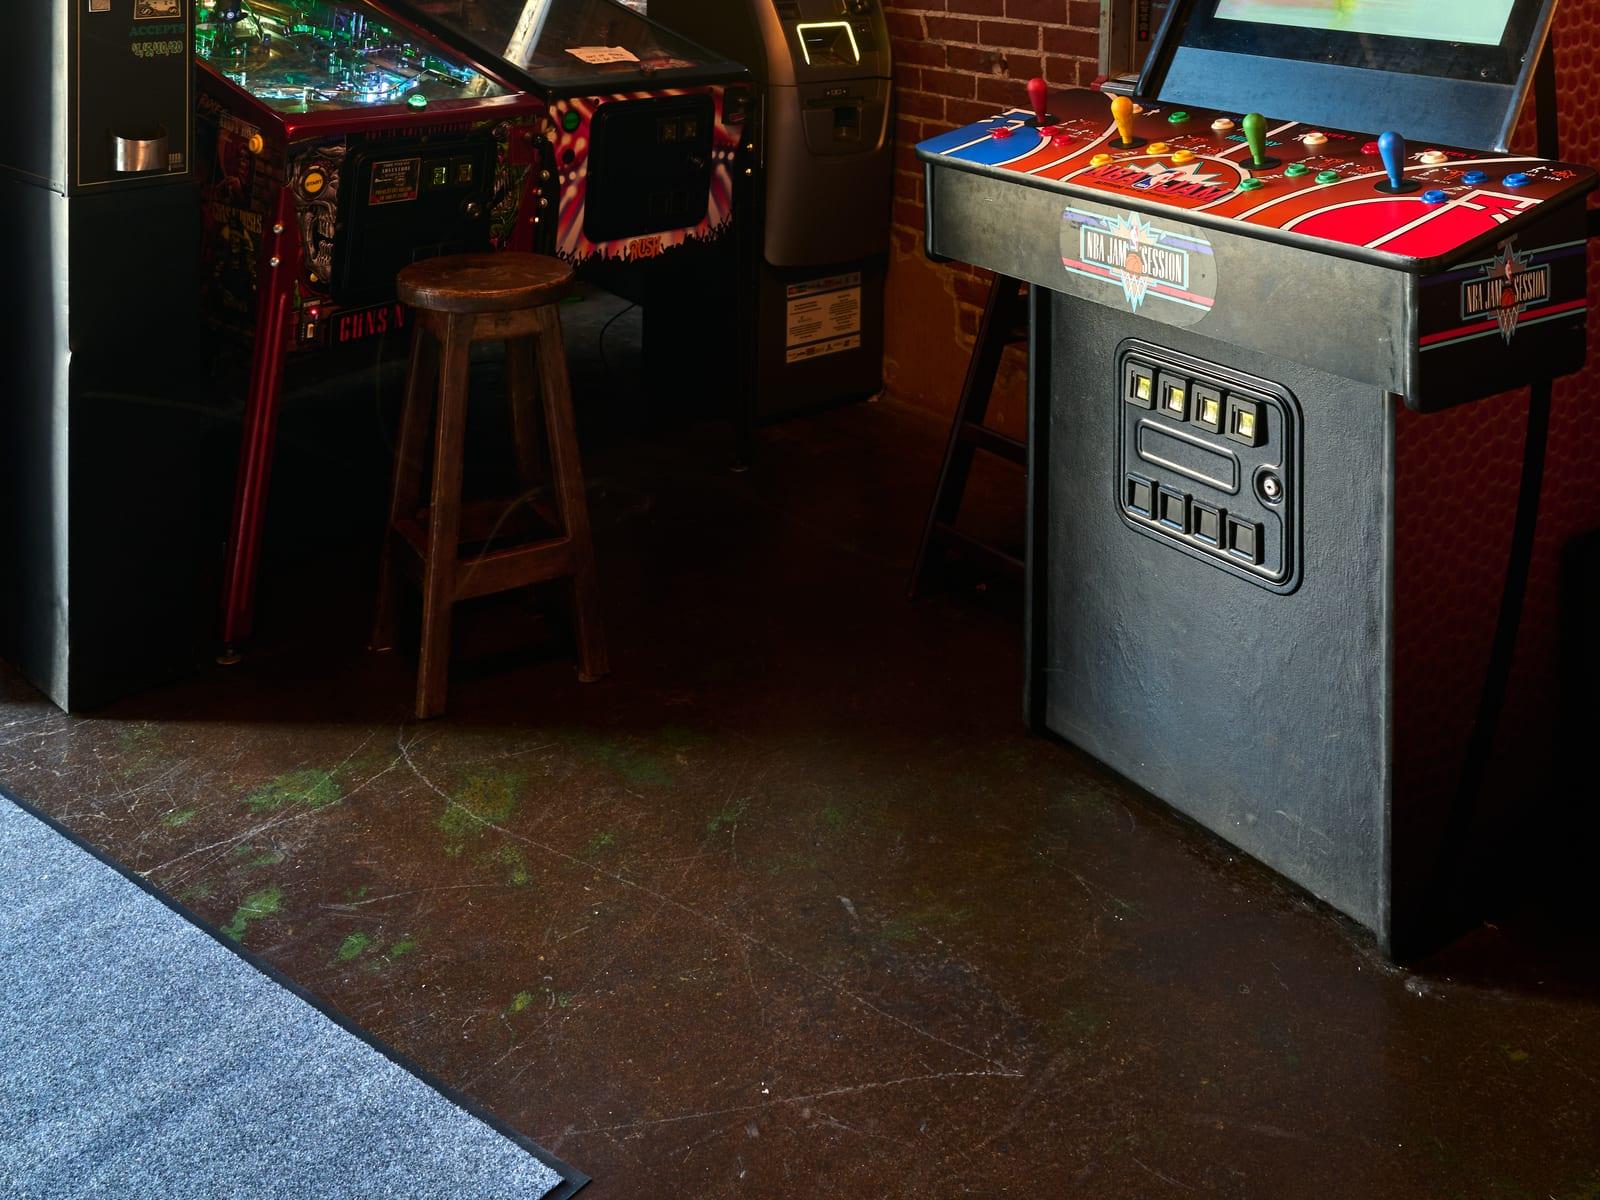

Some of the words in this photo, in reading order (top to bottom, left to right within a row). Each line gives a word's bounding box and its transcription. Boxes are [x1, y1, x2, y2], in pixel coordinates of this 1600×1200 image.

[128, 23, 185, 36] ACCEPTS
[1083, 164, 1150, 186] NBA
[1155, 177, 1235, 201] JAM
[629, 237, 660, 263] RUSH
[1086, 231, 1105, 262] NBA
[1107, 237, 1127, 268] JAM
[1141, 246, 1182, 283] SESSION
[1466, 283, 1482, 313] NBA
[1485, 279, 1502, 309] JAM
[1514, 269, 1546, 302] SESSION
[339, 306, 389, 343] GUNS
